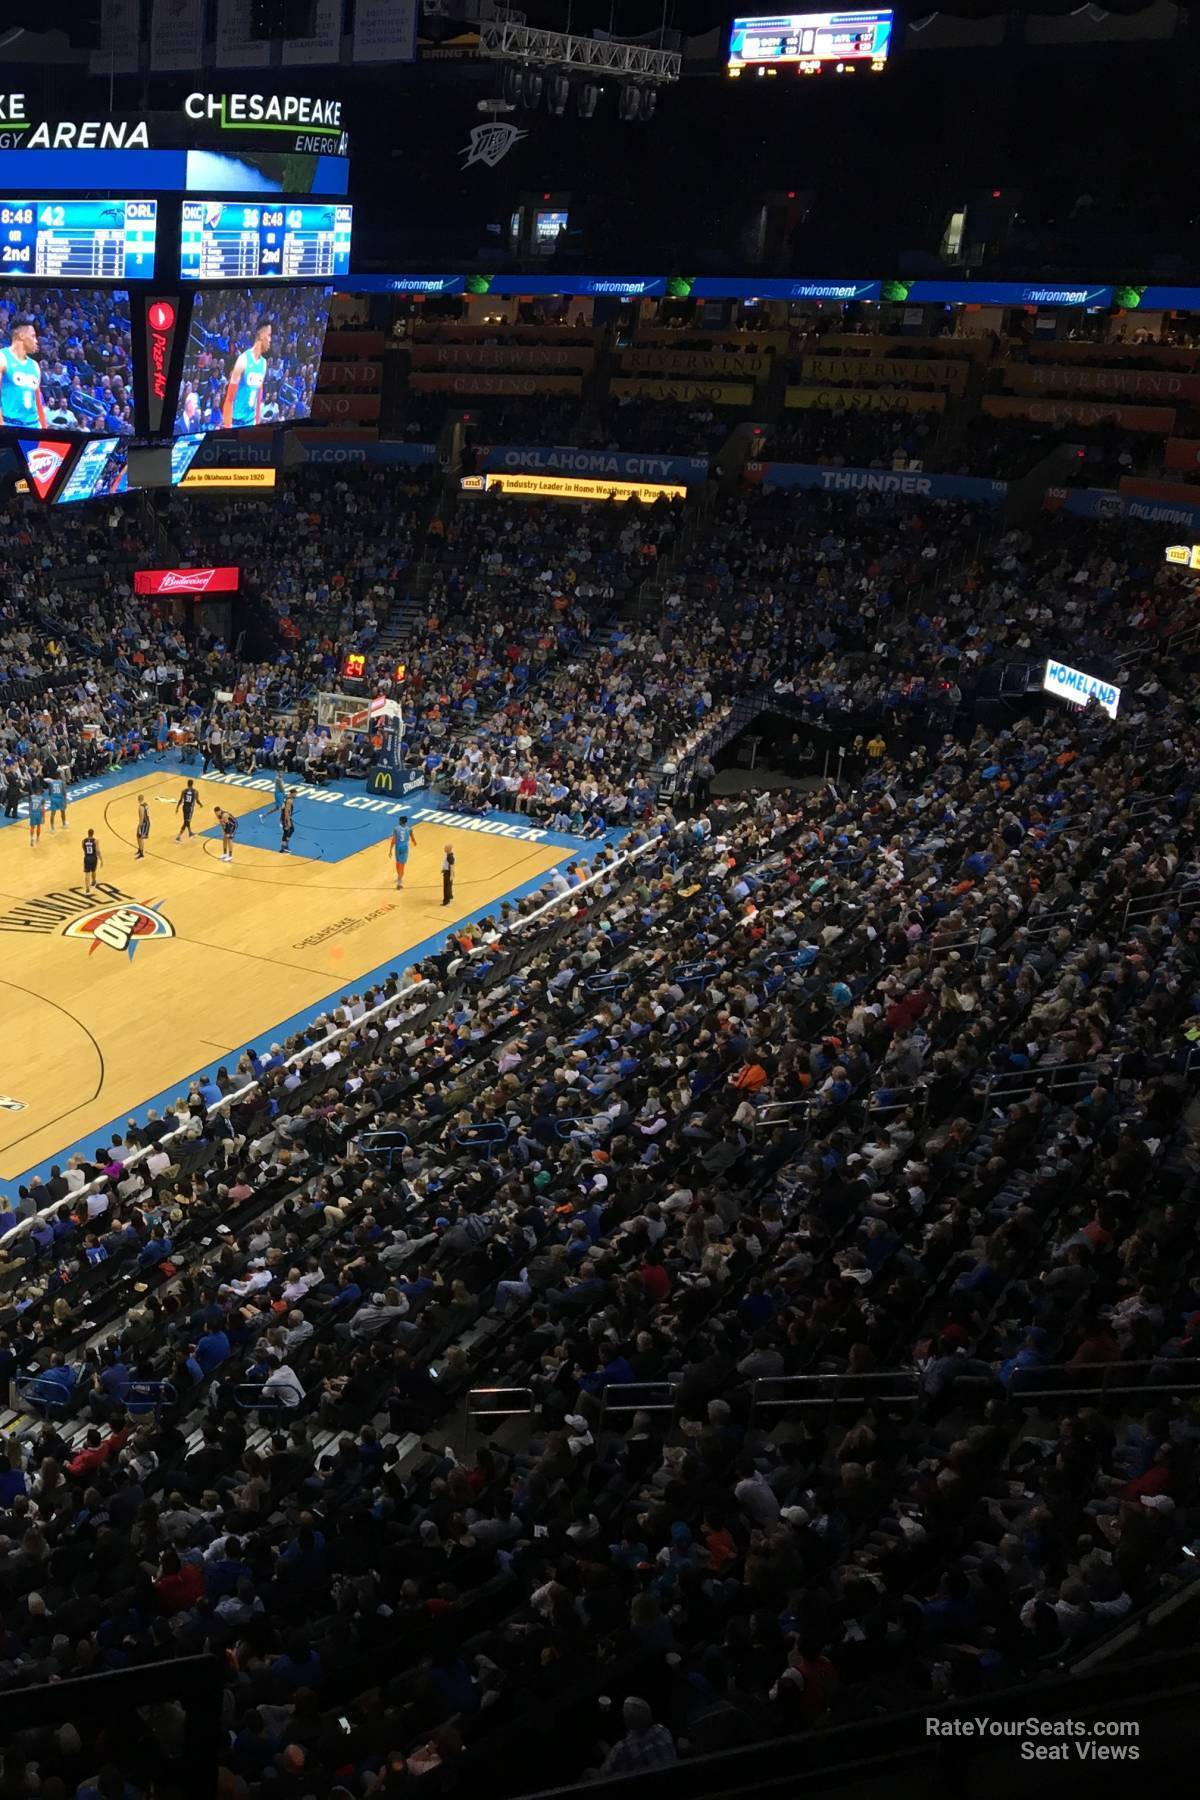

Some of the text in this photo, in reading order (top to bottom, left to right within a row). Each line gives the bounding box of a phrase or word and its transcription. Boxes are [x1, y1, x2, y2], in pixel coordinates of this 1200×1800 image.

[185, 92, 342, 126] CHESAPEAKE
[27, 121, 149, 149] ARENA
[295, 135, 338, 154] ENERGY
[0, 209, 33, 224] 8:48
[39, 206, 66, 227] 42
[127, 204, 155, 218] ORL
[184, 206, 202, 217] OKC
[262, 212, 284, 227] 8:48
[3, 246, 31, 262] 2nd
[262, 248, 280, 263] 2nd
[437, 348, 569, 365] RIVERWIND
[631, 352, 763, 373] RIVERWIND
[152, 332, 168, 400] Pizza Hut
[812, 359, 960, 380] RIVERWIND
[453, 376, 536, 393] CASINO
[817, 391, 910, 411] CASINO
[504, 450, 673, 476] OKLAHOMA CITY
[690, 458, 708, 469] 120
[746, 462, 763, 472] 101
[184, 473, 198, 481] ade
[233, 473, 249, 481] Since
[250, 473, 265, 481] 1920
[506, 479, 537, 492] Industry
[539, 481, 563, 492] Leader
[573, 483, 594, 493] Home
[821, 471, 932, 495] THUNDER
[990, 480, 1008, 491] 101
[1048, 487, 1068, 498] 102
[1129, 502, 1195, 527] OKLAHOMA
[164, 576, 210, 587] Budweiser
[346, 663, 363, 676] 24
[1049, 663, 1117, 706] HOMELAND
[402, 775, 425, 795] SPALDING
[343, 796, 412, 815] CITY
[410, 807, 548, 841] THUNDER
[93, 909, 140, 951] OKC
[292, 917, 356, 950] CHESAPEAKE
